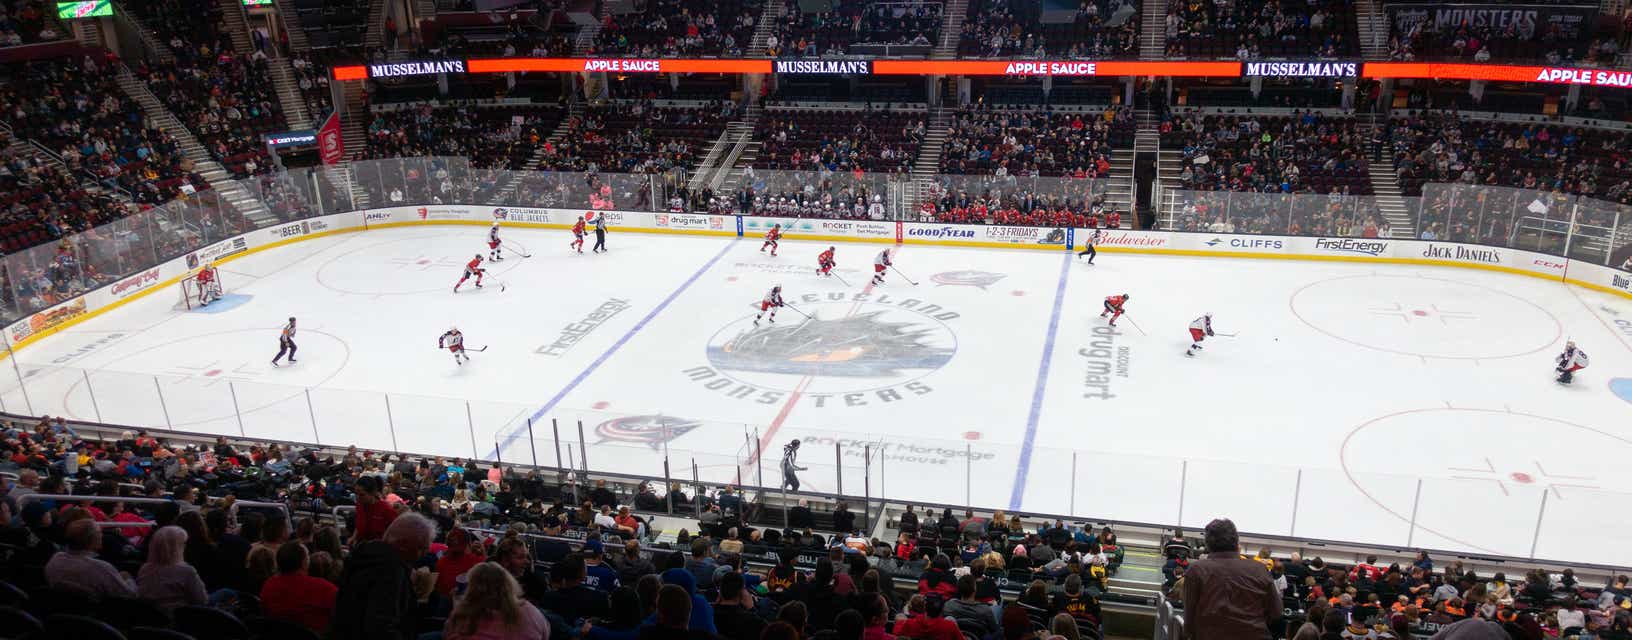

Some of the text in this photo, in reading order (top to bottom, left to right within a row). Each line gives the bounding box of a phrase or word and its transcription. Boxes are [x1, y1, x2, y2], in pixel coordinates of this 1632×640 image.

[1433, 10, 1538, 38] MONSTERS
[584, 60, 660, 71] APPLE SAUCE
[1005, 63, 1096, 75] APPLE SAUCE
[1536, 69, 1632, 87] APPLE SAU
[671, 216, 688, 226] drug
[690, 217, 707, 225] mart
[822, 222, 853, 230] ROCKET
[282, 224, 301, 237] BEER
[908, 228, 975, 238] GOODYEAR
[986, 226, 1039, 237] 1-2-3 FRIDAYS
[1099, 230, 1166, 247] Budweiser
[1230, 238, 1283, 249] CLIFFS
[1315, 238, 1388, 254] FirstEnergy
[1422, 243, 1501, 263] JACK DANIEL'S
[1533, 259, 1564, 270] CCM
[1611, 274, 1630, 290] Blue
[535, 297, 632, 357] FirstEnergy
[1078, 326, 1123, 401] drug mart
[896, 443, 996, 461] Mortgage
